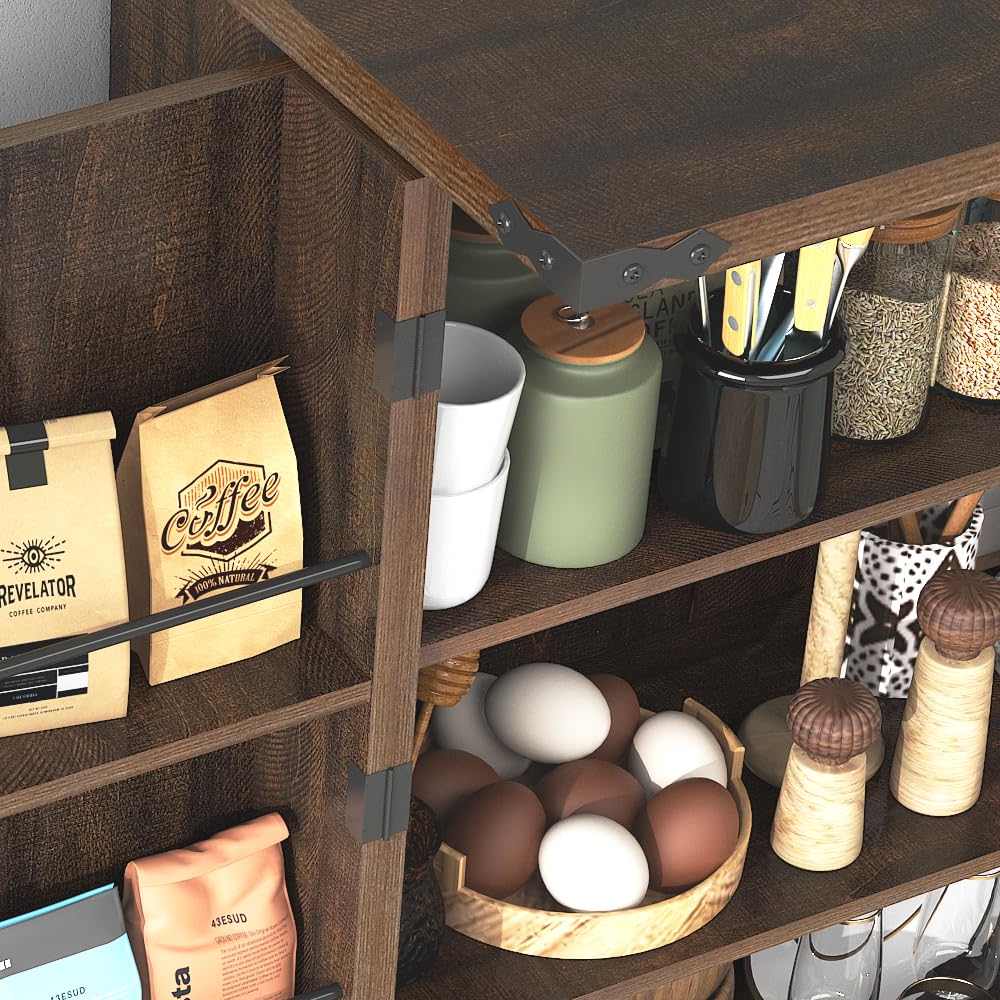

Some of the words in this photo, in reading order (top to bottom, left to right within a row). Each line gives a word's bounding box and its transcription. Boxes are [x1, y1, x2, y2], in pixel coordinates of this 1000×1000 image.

[161, 472, 280, 555] Coffee
[194, 579, 217, 594] 100%
[218, 572, 255, 586] NATURAL
[9, 608, 33, 617] COFFEE
[36, 604, 67, 613] COMPANY
[211, 913, 248, 928] 43ESUD
